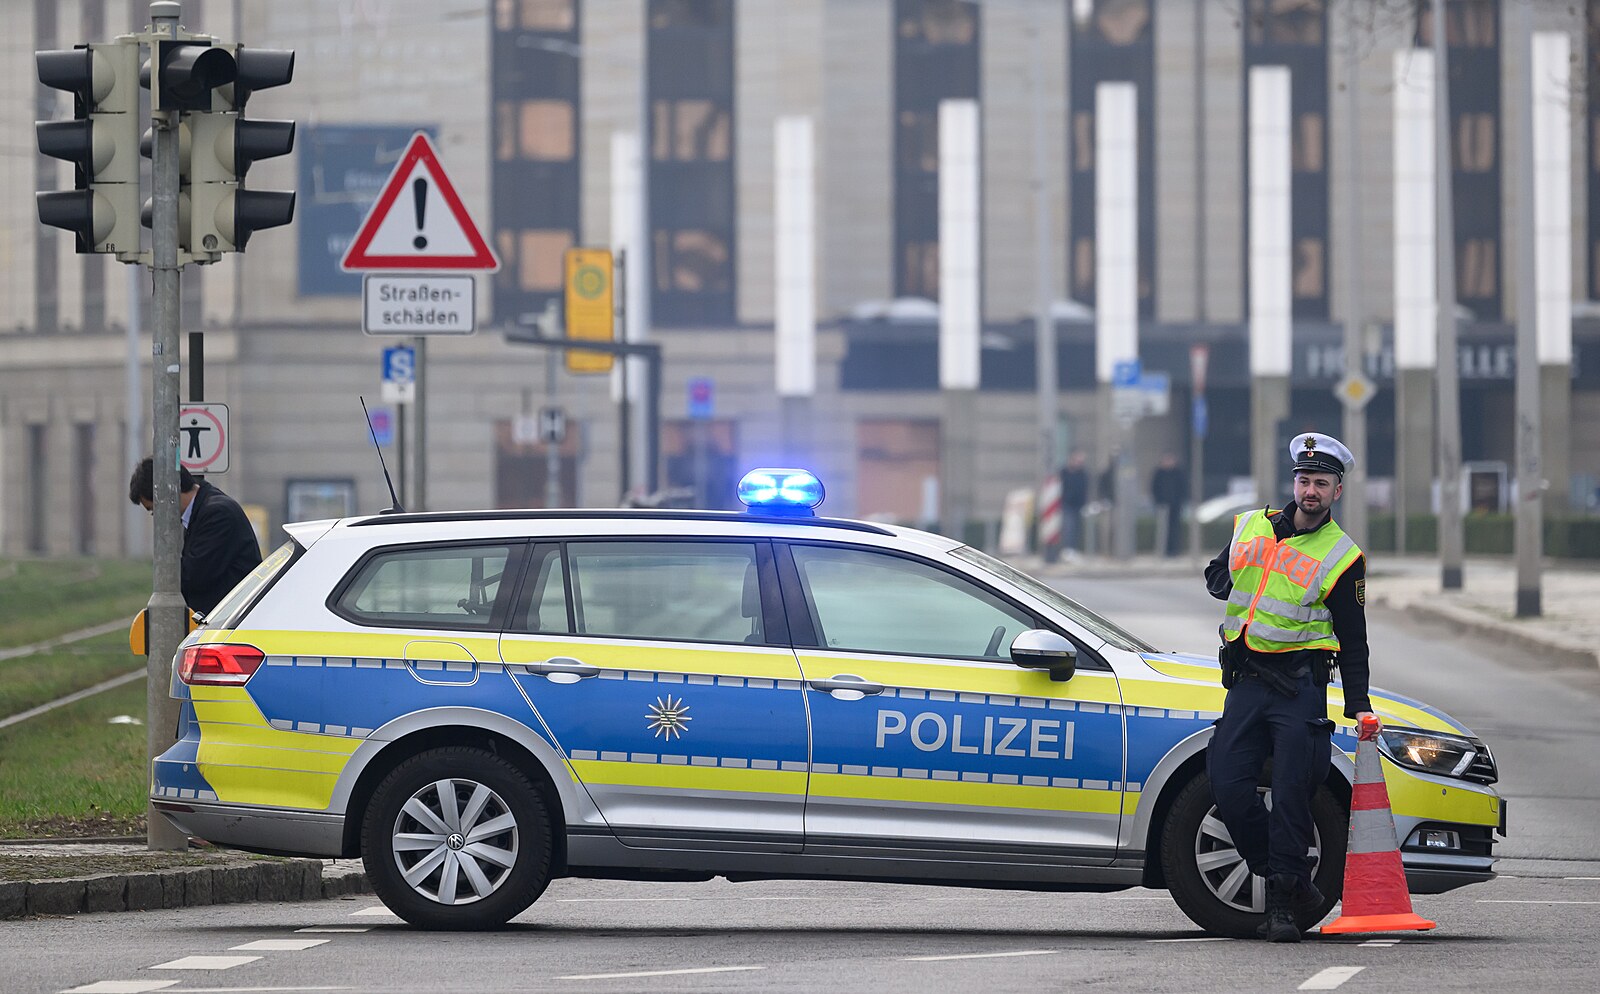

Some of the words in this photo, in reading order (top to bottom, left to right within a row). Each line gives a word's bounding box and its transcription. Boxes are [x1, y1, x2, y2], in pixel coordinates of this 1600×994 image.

[379, 283, 461, 302] Straßen-
[382, 307, 458, 325] schäden
[389, 349, 412, 383] S
[875, 709, 1075, 760] POLIZEI
